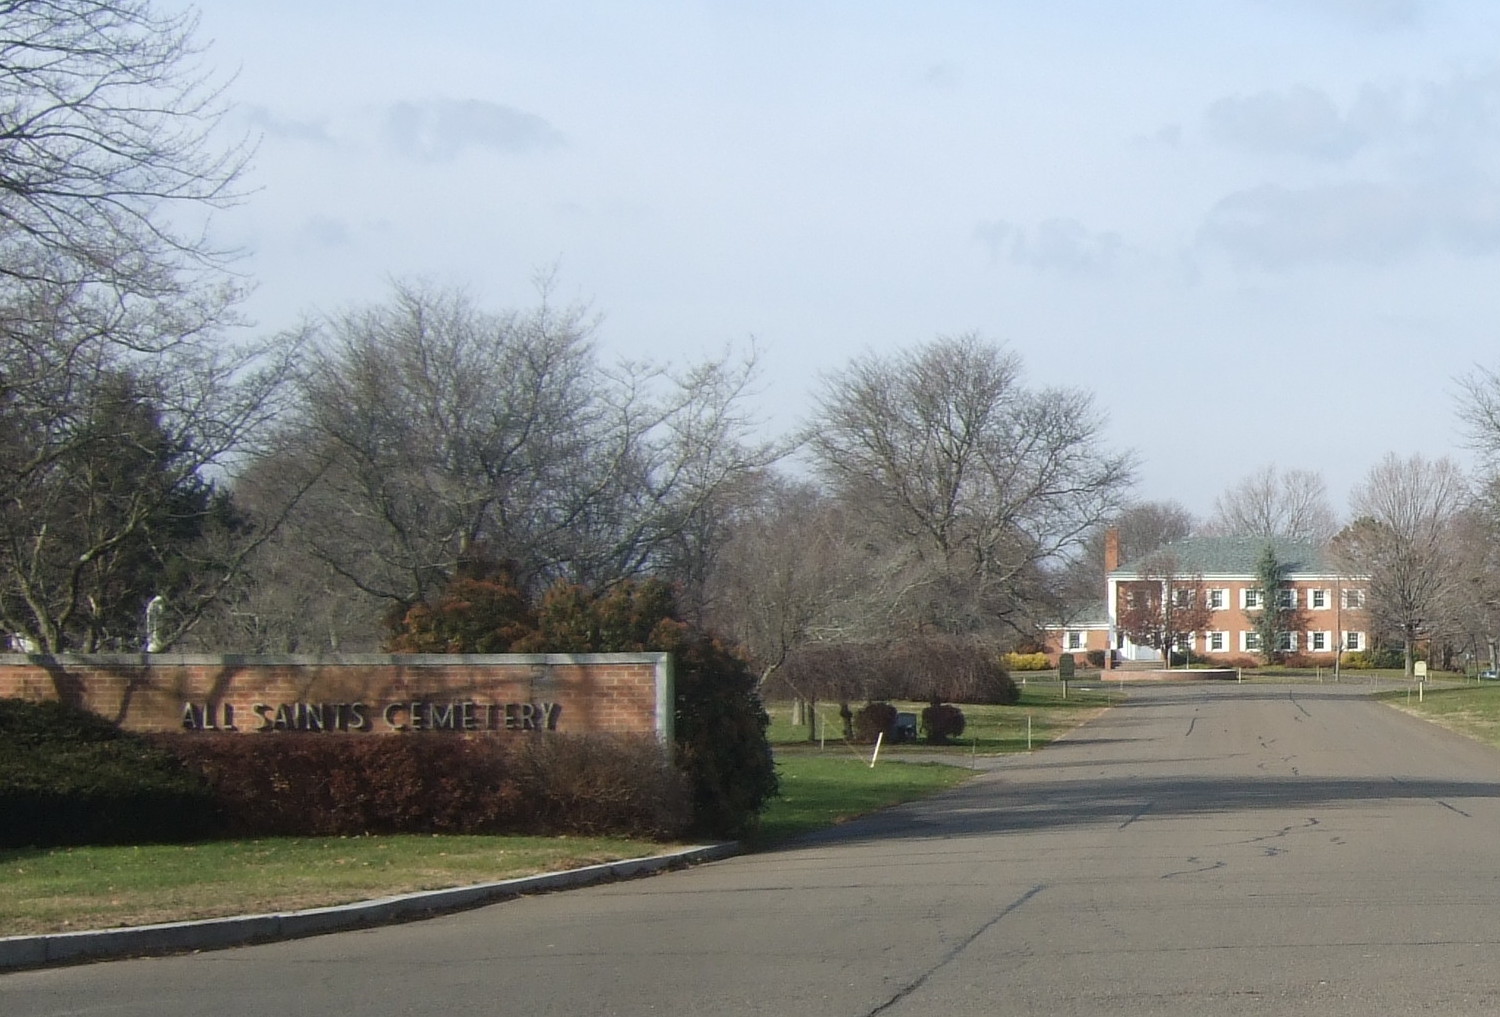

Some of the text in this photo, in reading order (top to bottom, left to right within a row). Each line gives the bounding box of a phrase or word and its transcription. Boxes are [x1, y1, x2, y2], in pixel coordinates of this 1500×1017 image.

[182, 701, 555, 731] ALL SAINTS CEMETERY
